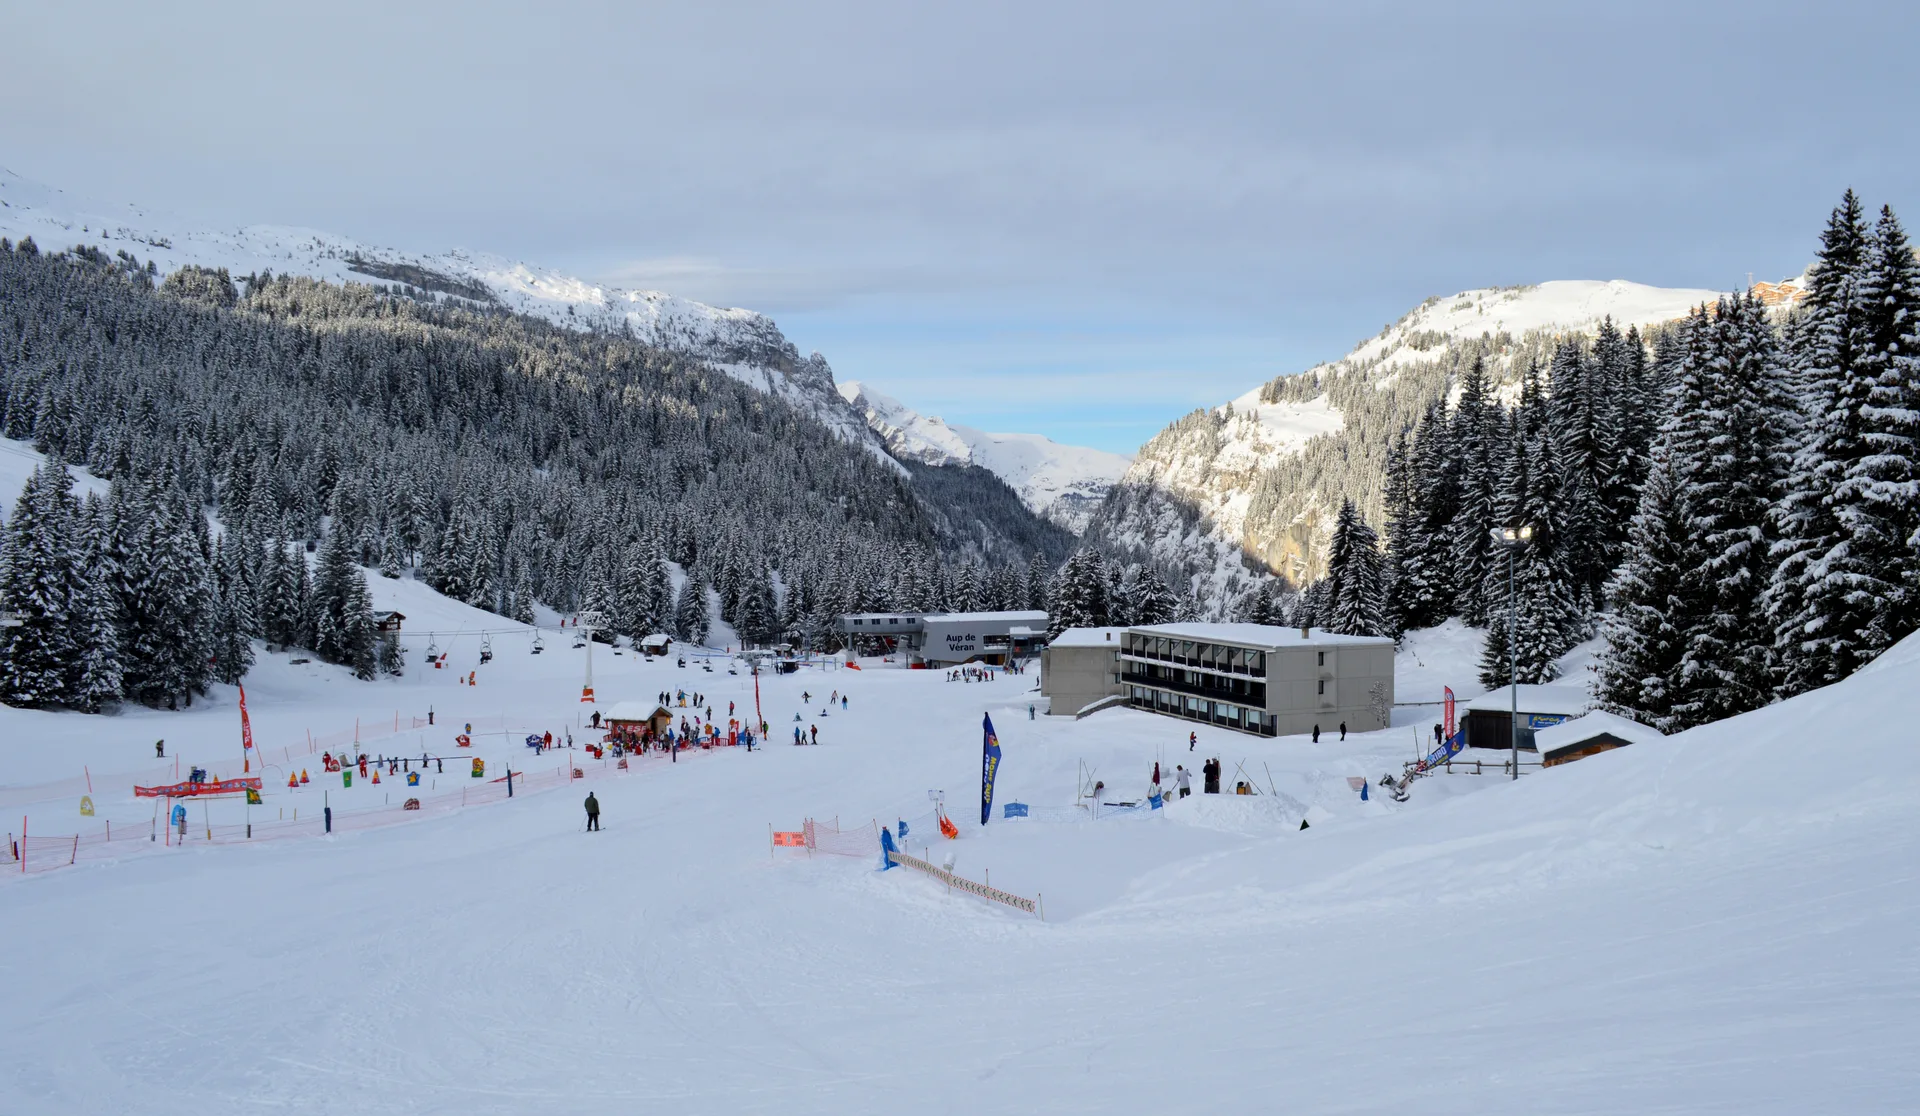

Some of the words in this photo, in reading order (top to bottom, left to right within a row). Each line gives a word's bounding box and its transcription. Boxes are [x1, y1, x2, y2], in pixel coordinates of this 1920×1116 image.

[946, 634, 963, 643] Aup
[965, 633, 976, 641] de
[949, 643, 974, 651] Véran
